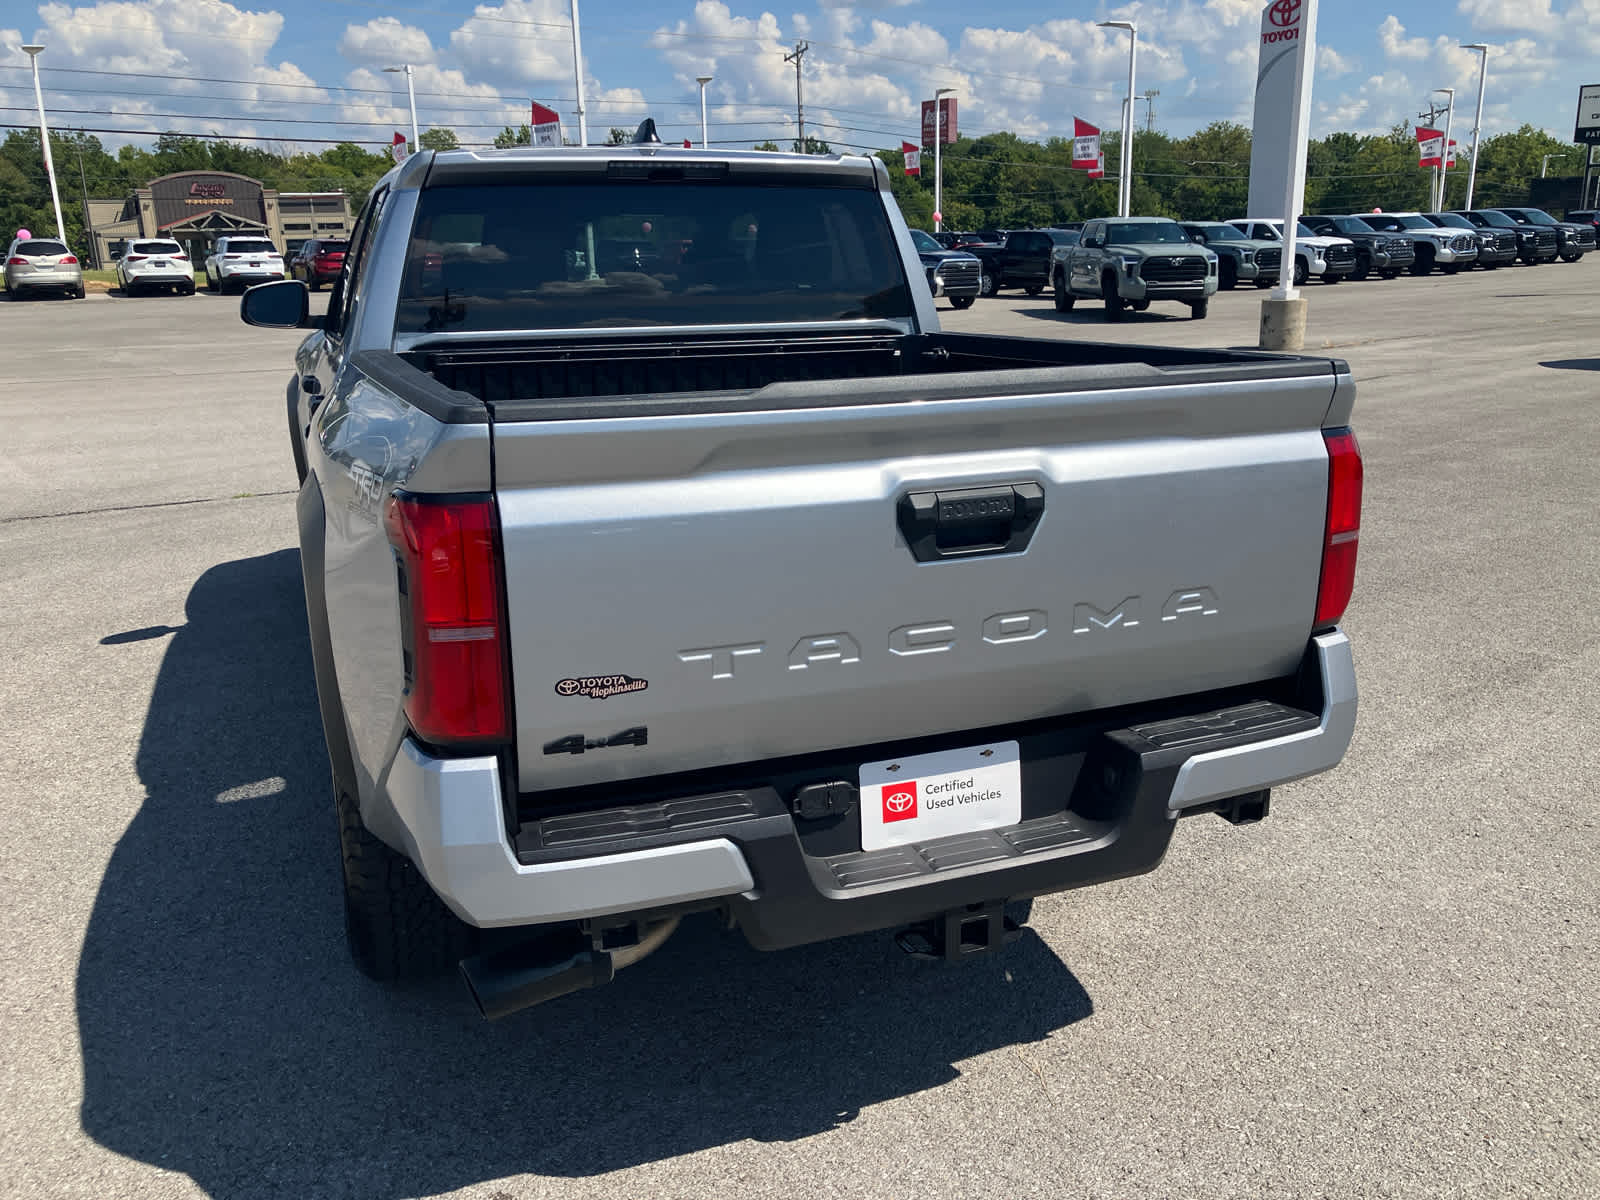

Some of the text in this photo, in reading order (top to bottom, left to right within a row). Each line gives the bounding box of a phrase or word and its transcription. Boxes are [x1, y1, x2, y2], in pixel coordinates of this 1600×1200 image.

[1262, 28, 1299, 45] TOYOT
[943, 500, 1012, 518] TOYOTA
[678, 586, 1218, 679] TACOMA
[580, 676, 627, 688] TOYOTA
[591, 680, 647, 698] Hopkinsville
[925, 777, 974, 795] Certified
[926, 789, 1002, 810] Used Vehicles
